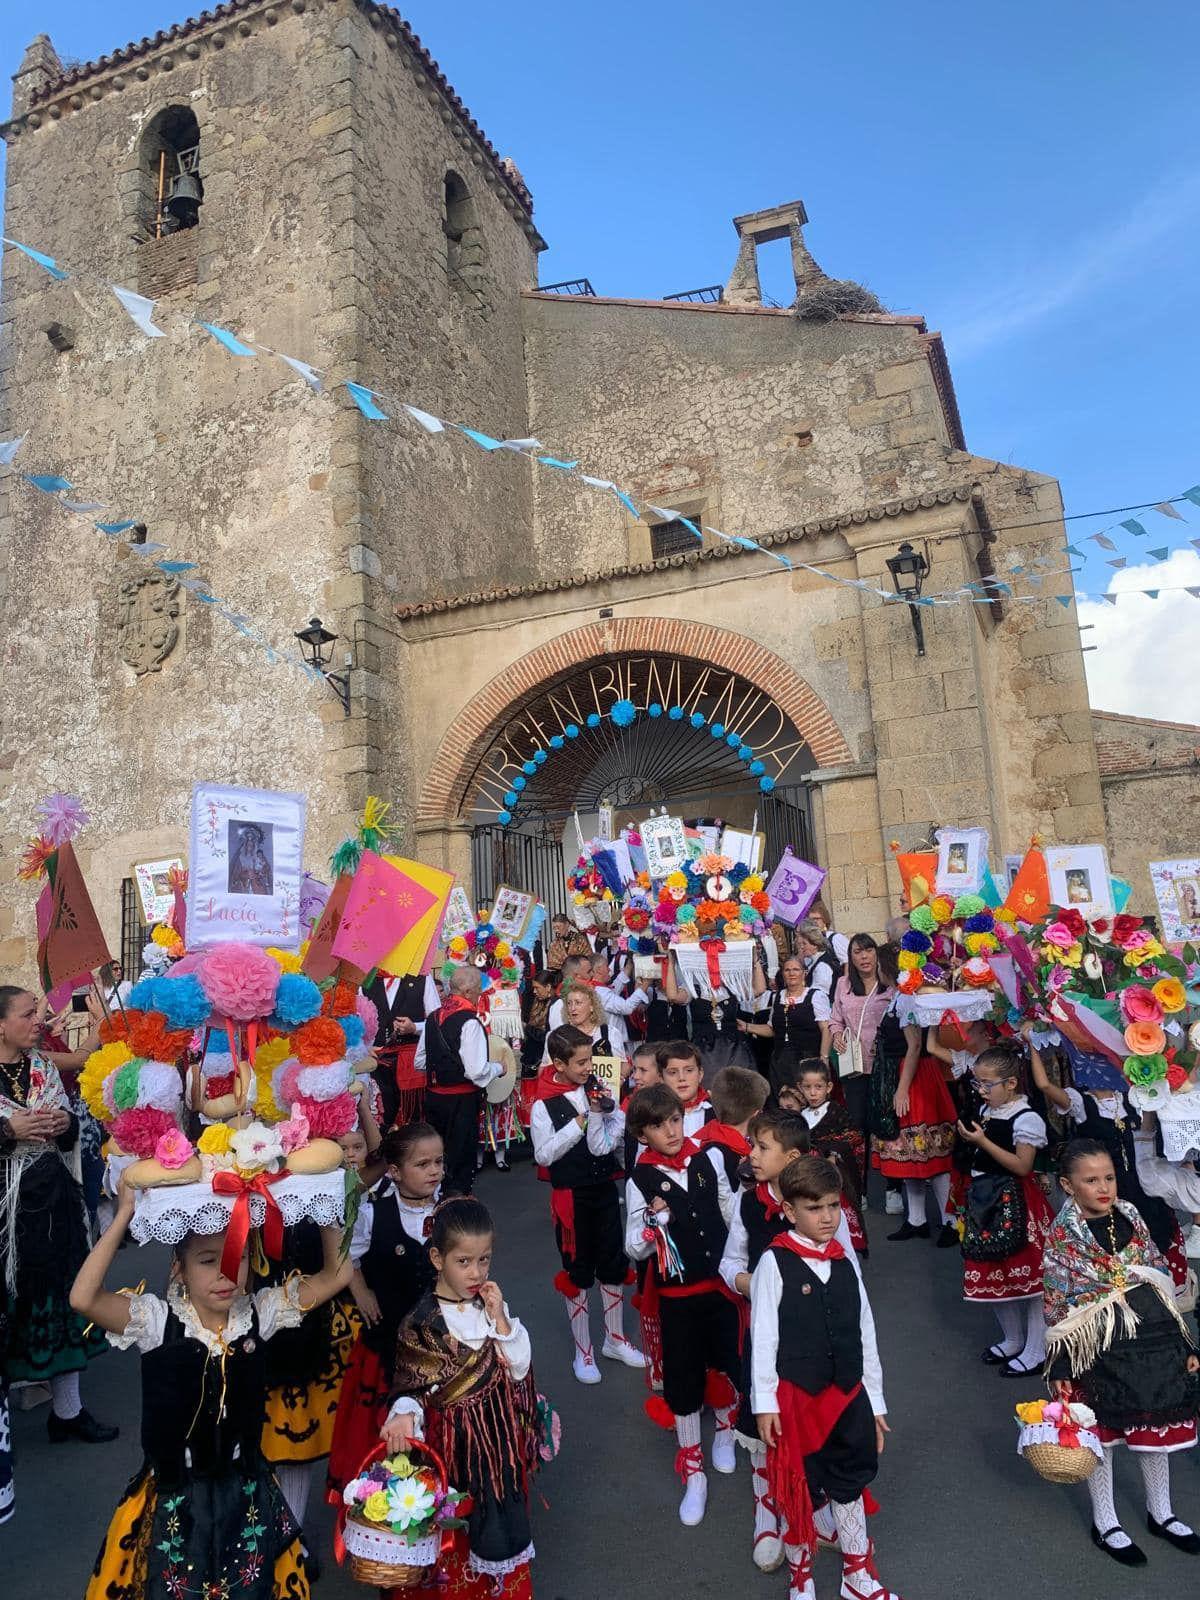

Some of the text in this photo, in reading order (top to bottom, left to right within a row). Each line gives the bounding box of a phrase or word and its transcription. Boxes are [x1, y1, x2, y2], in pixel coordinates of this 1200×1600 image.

[467, 658, 806, 814] VIRGEN BIENVENIDA
[207, 896, 257, 921] Lucía
